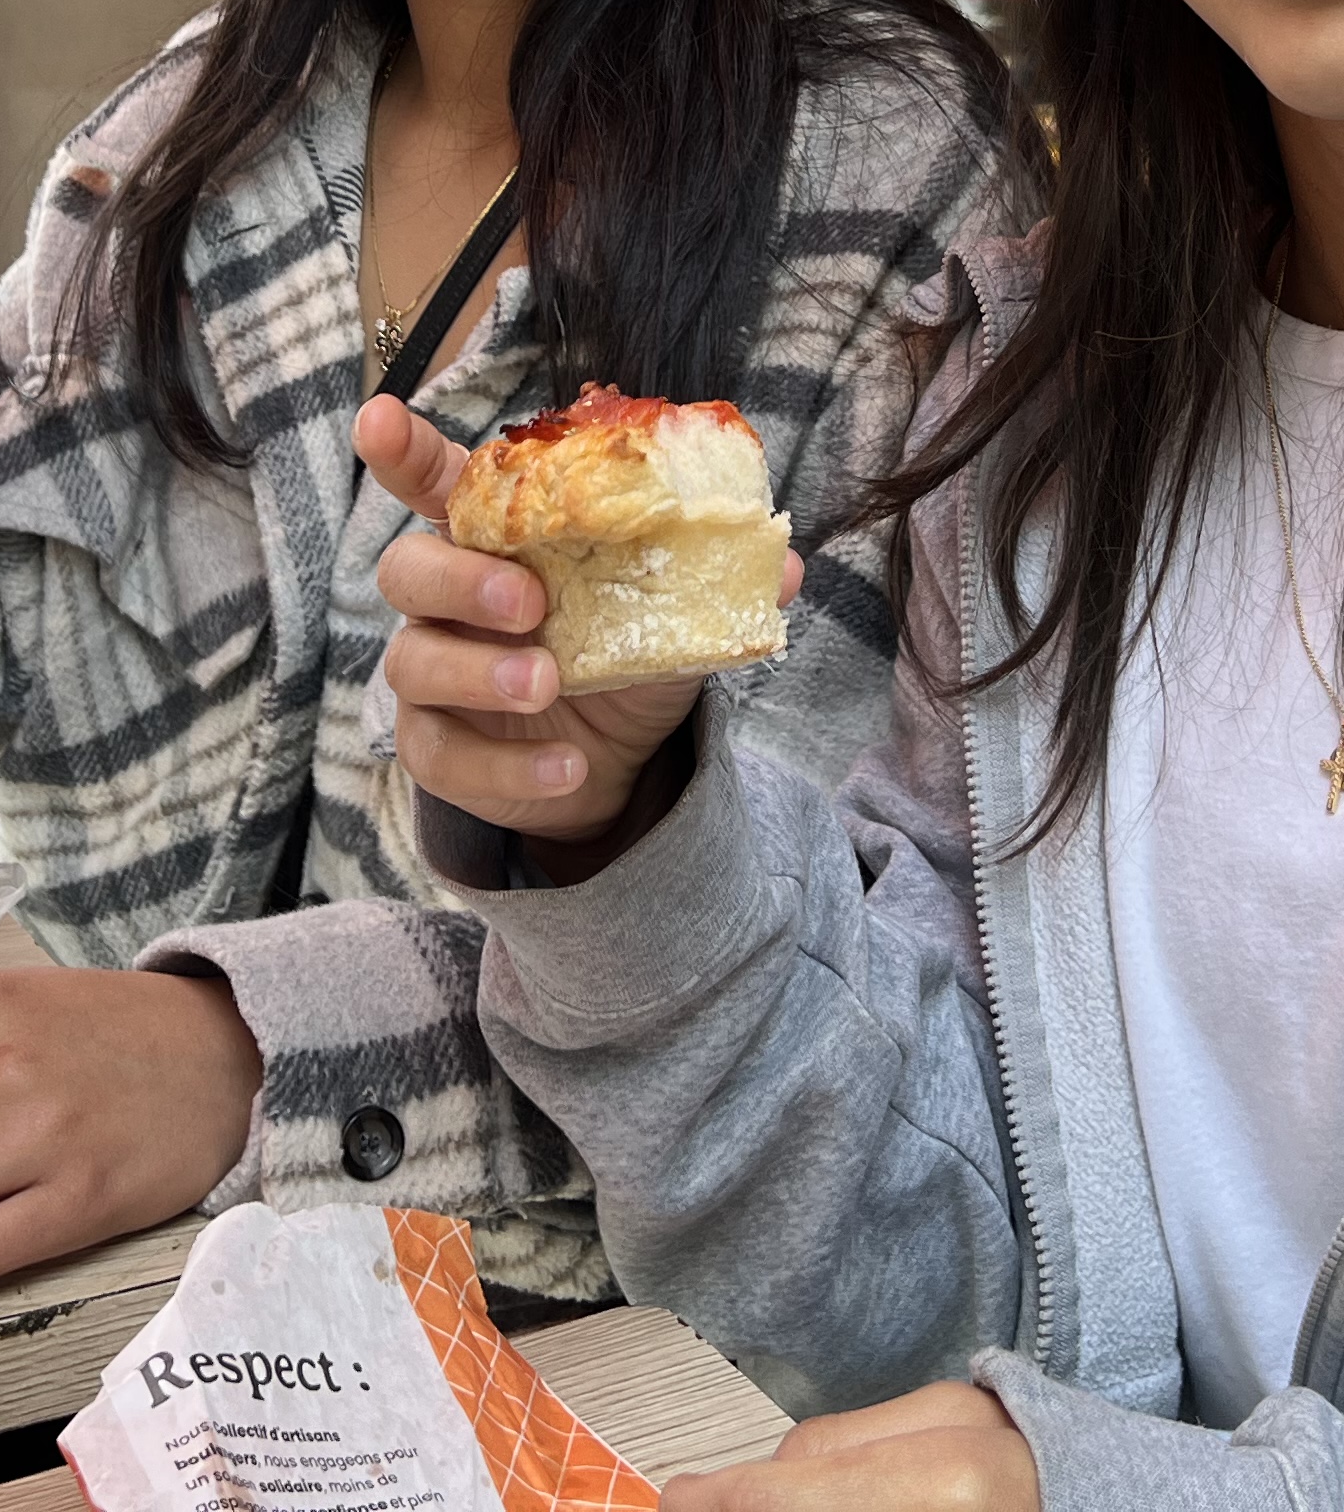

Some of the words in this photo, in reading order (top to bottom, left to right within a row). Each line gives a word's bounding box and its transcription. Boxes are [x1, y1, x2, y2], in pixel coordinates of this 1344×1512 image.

[136, 1350, 341, 1408] Respect
[165, 1420, 211, 1452] Nous
[269, 1427, 341, 1443] d'artisans
[264, 1454, 298, 1469] nous
[300, 1452, 382, 1473] engageons
[383, 1446, 419, 1465] pour
[185, 1474, 210, 1491] un
[259, 1478, 328, 1495] solidaire,
[329, 1478, 375, 1494] moins
[377, 1473, 398, 1486] de
[390, 1496, 407, 1509] et
